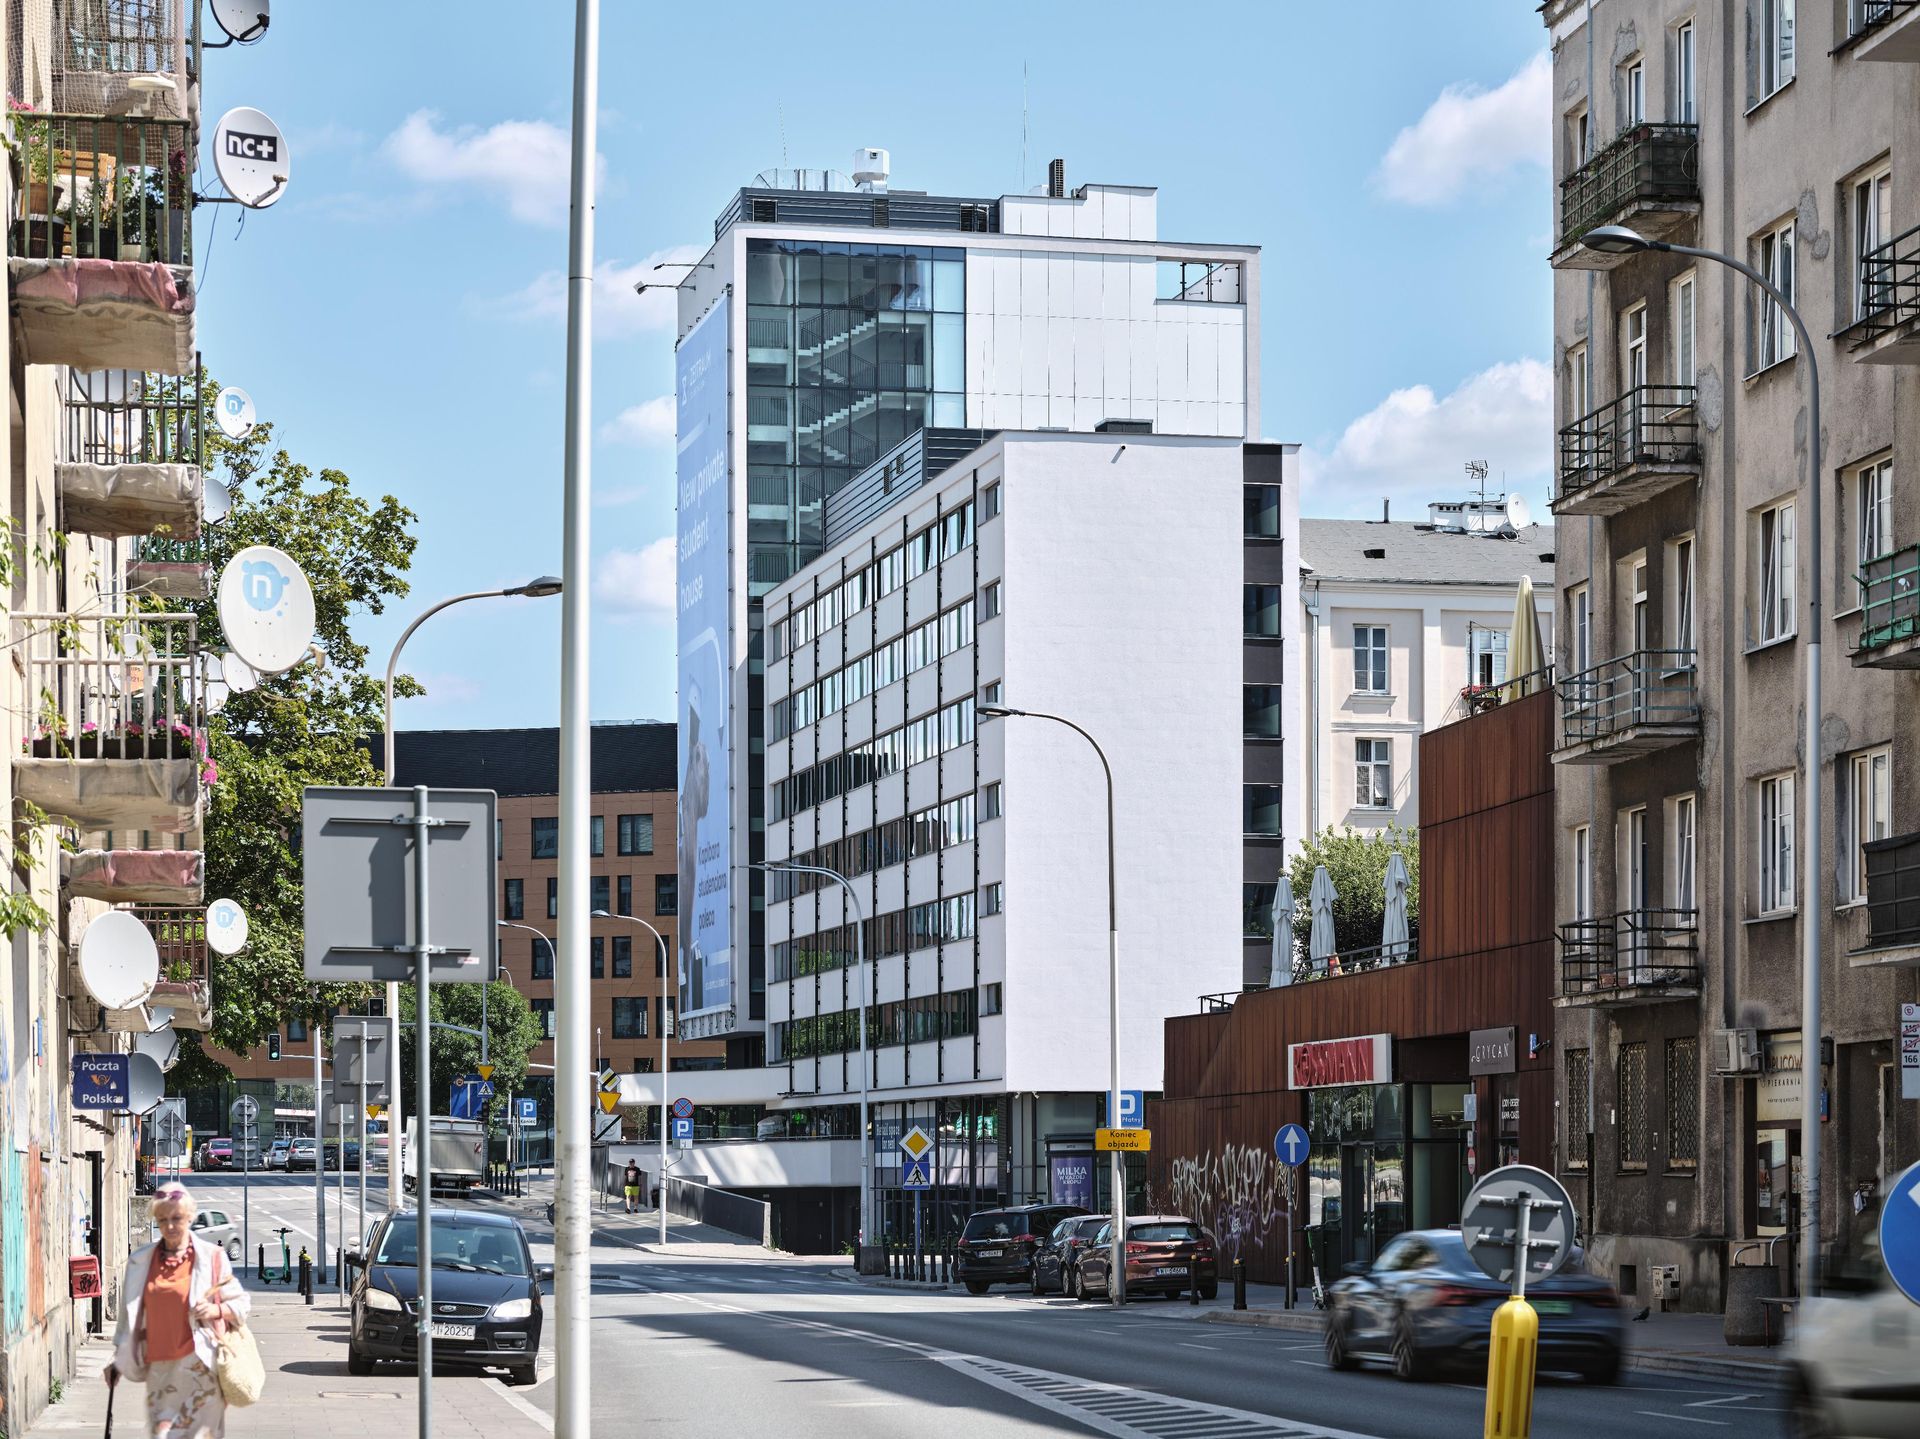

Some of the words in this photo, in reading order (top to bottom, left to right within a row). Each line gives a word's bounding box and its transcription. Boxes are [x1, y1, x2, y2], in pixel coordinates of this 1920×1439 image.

[228, 134, 274, 159] nc+
[680, 477, 697, 513] New
[698, 448, 724, 508] private
[680, 511, 709, 563] student
[252, 574, 272, 599] n
[680, 573, 703, 614] house
[698, 908, 715, 937] poleca
[82, 1061, 119, 1071] Poczta
[1904, 1055, 1918, 1063] 166
[524, 1102, 534, 1115] P
[677, 1121, 689, 1136] P
[1108, 1141, 1139, 1149] objazdu
[1057, 1167, 1087, 1175] MILKA
[444, 1326, 472, 1337] 2025C
